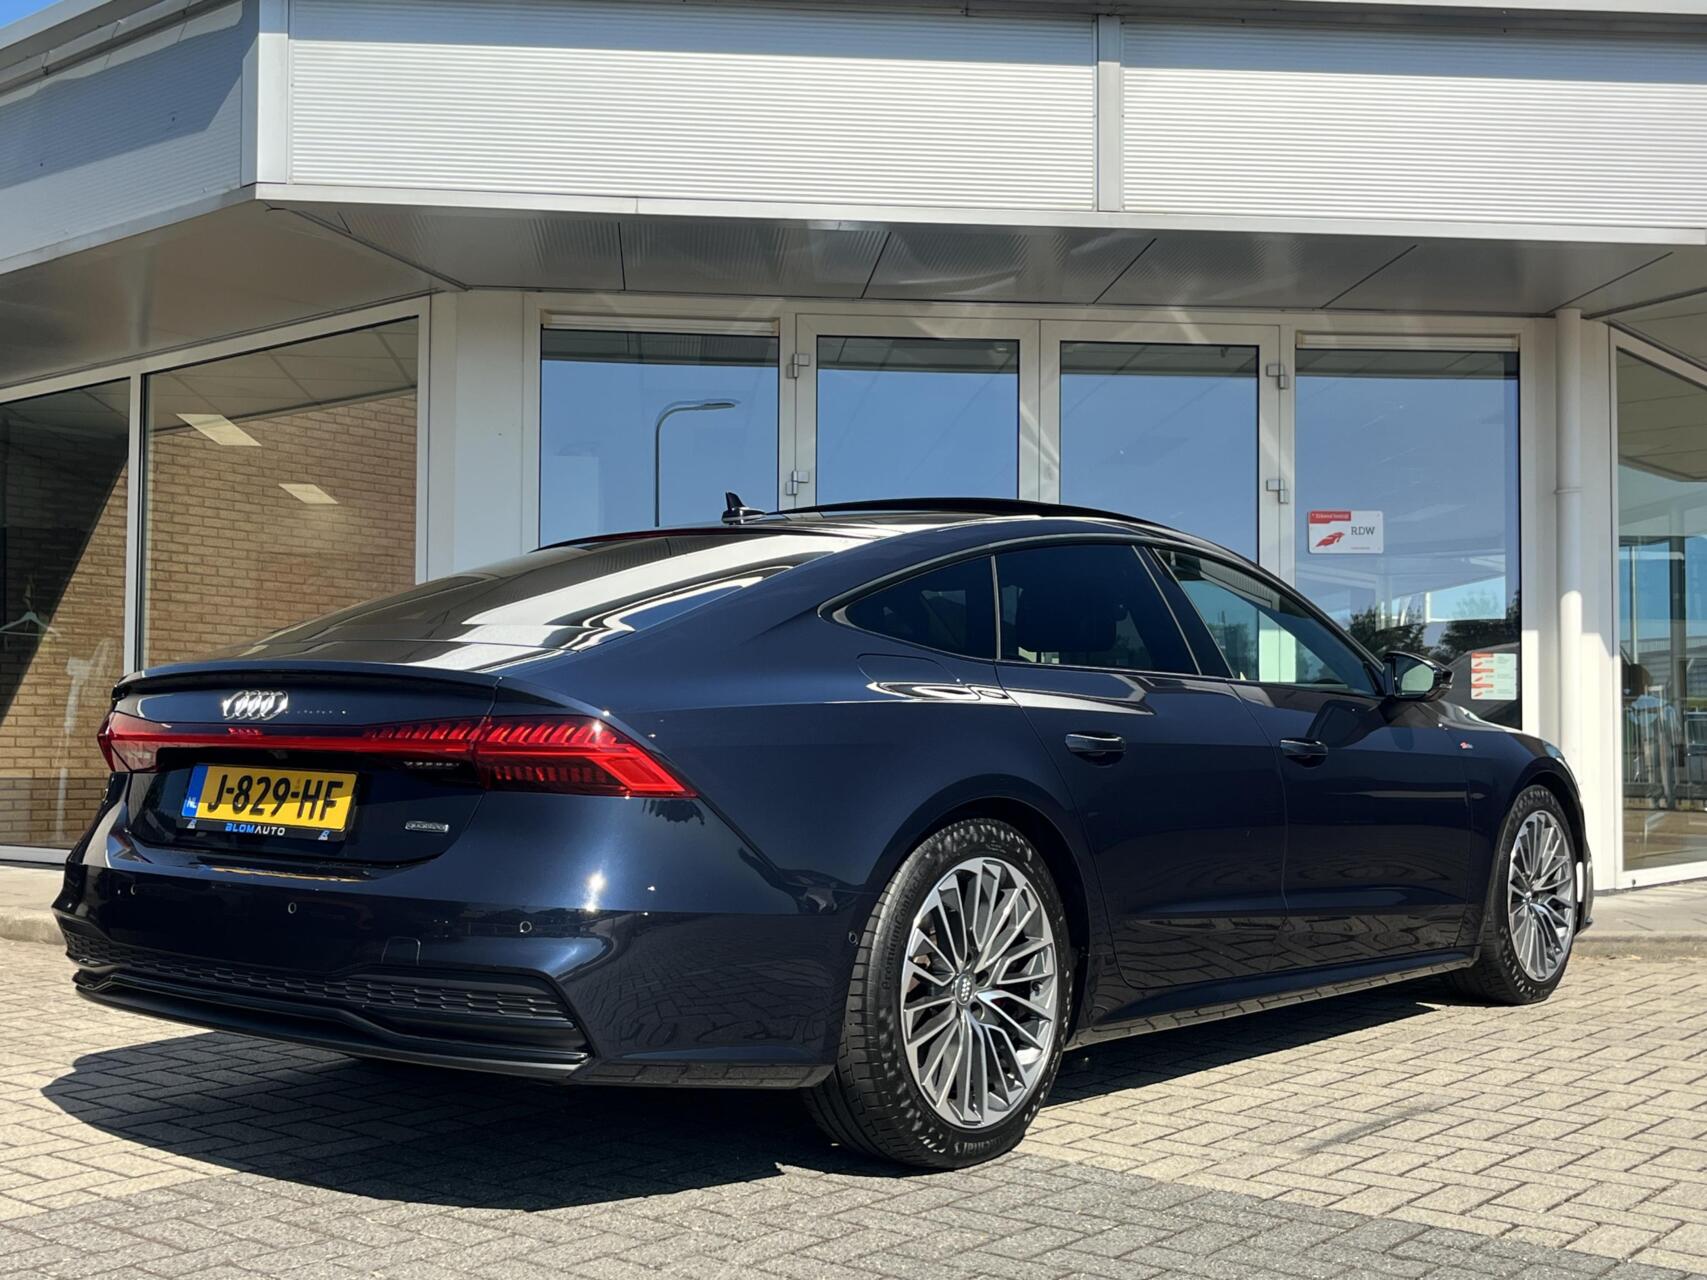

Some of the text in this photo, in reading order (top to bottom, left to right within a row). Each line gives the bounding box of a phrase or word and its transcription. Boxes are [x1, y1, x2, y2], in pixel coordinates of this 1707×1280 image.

[1350, 526, 1376, 536] RDW
[186, 796, 197, 809] NL
[207, 774, 344, 821] J-829-HF
